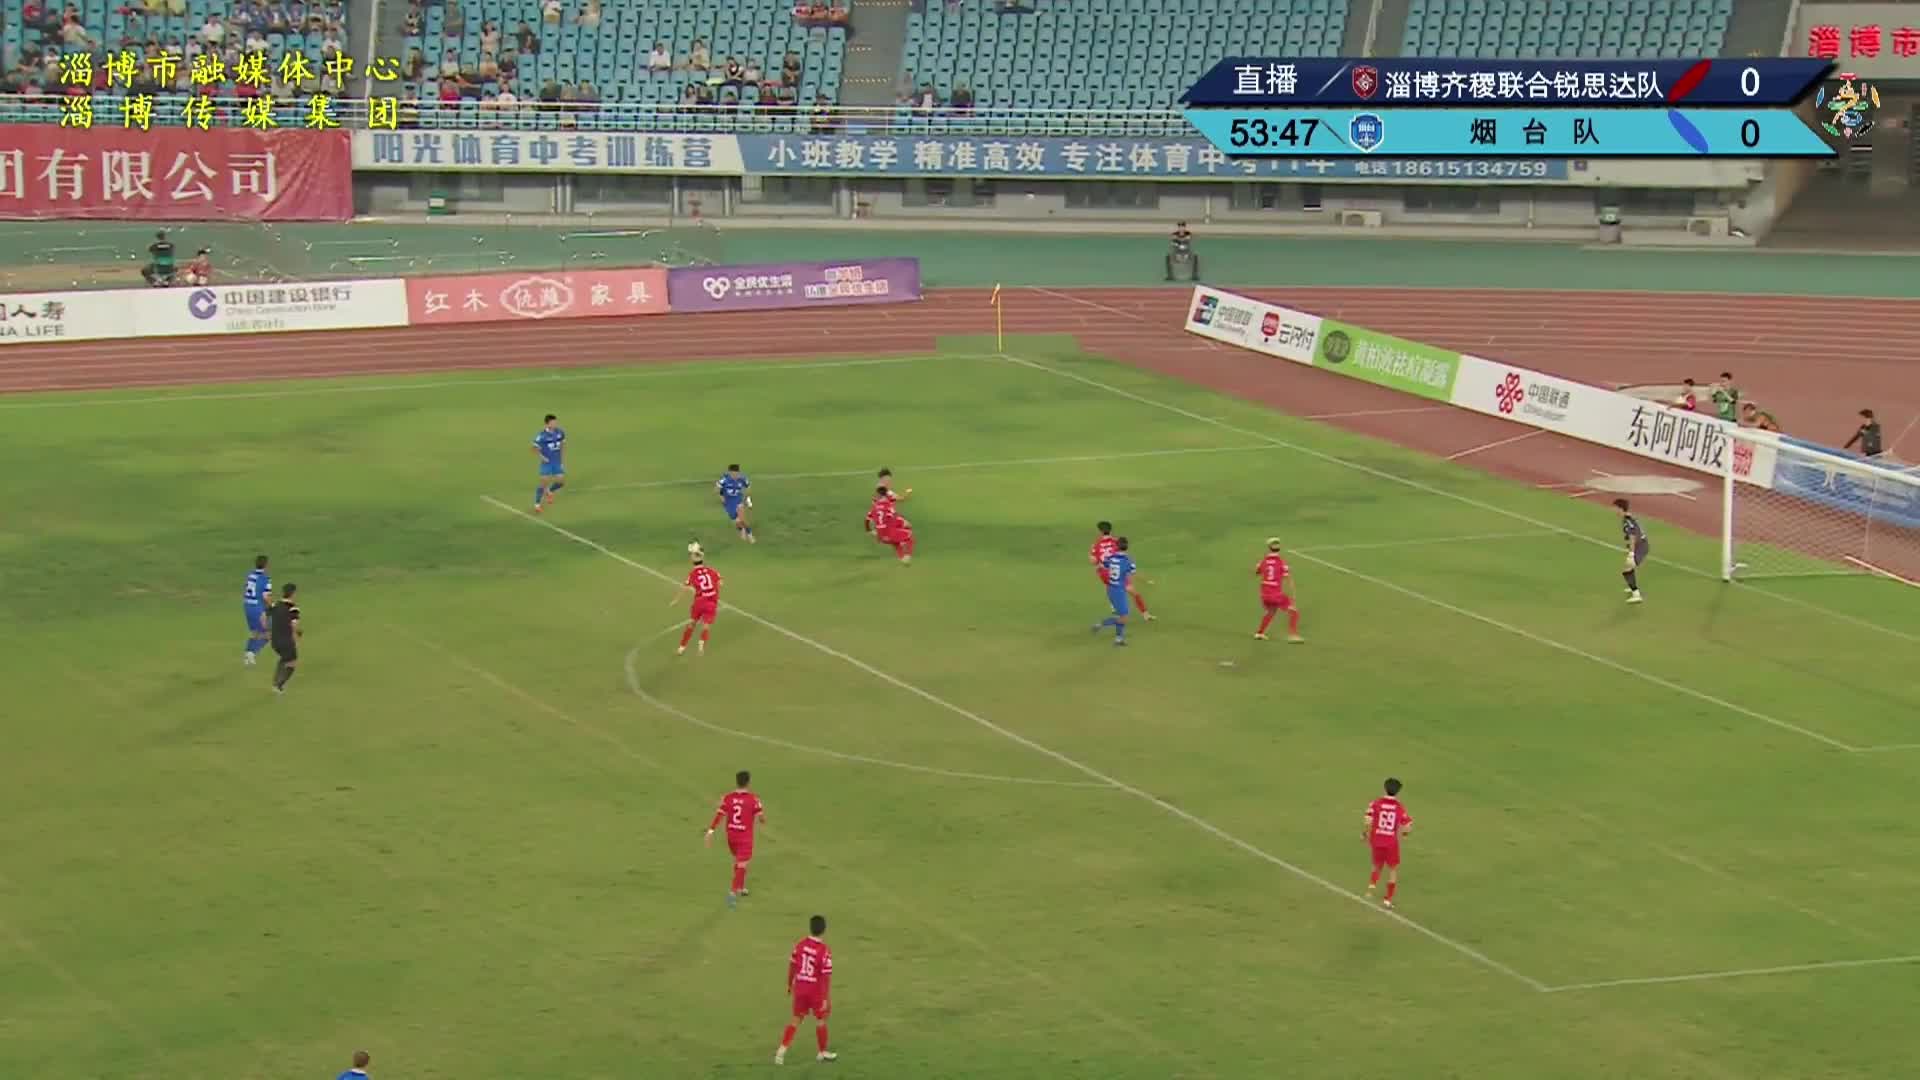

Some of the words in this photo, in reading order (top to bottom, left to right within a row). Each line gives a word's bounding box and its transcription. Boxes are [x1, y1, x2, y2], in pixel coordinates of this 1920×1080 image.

[1809, 26, 1920, 58] 淄博市
[373, 133, 713, 167] 阳光体育中考训练营
[767, 140, 898, 169] 小班教学
[914, 140, 1046, 171] 精准高效
[1392, 161, 1548, 176] 18615134759
[224, 287, 351, 305] 中国建设银行
[424, 288, 489, 314] 红木
[591, 281, 652, 306] 家具
[25, 324, 65, 336] LIFE
[1628, 405, 1727, 468] 东阿阿胶
[698, 573, 713, 591] 21
[732, 804, 742, 824] 2
